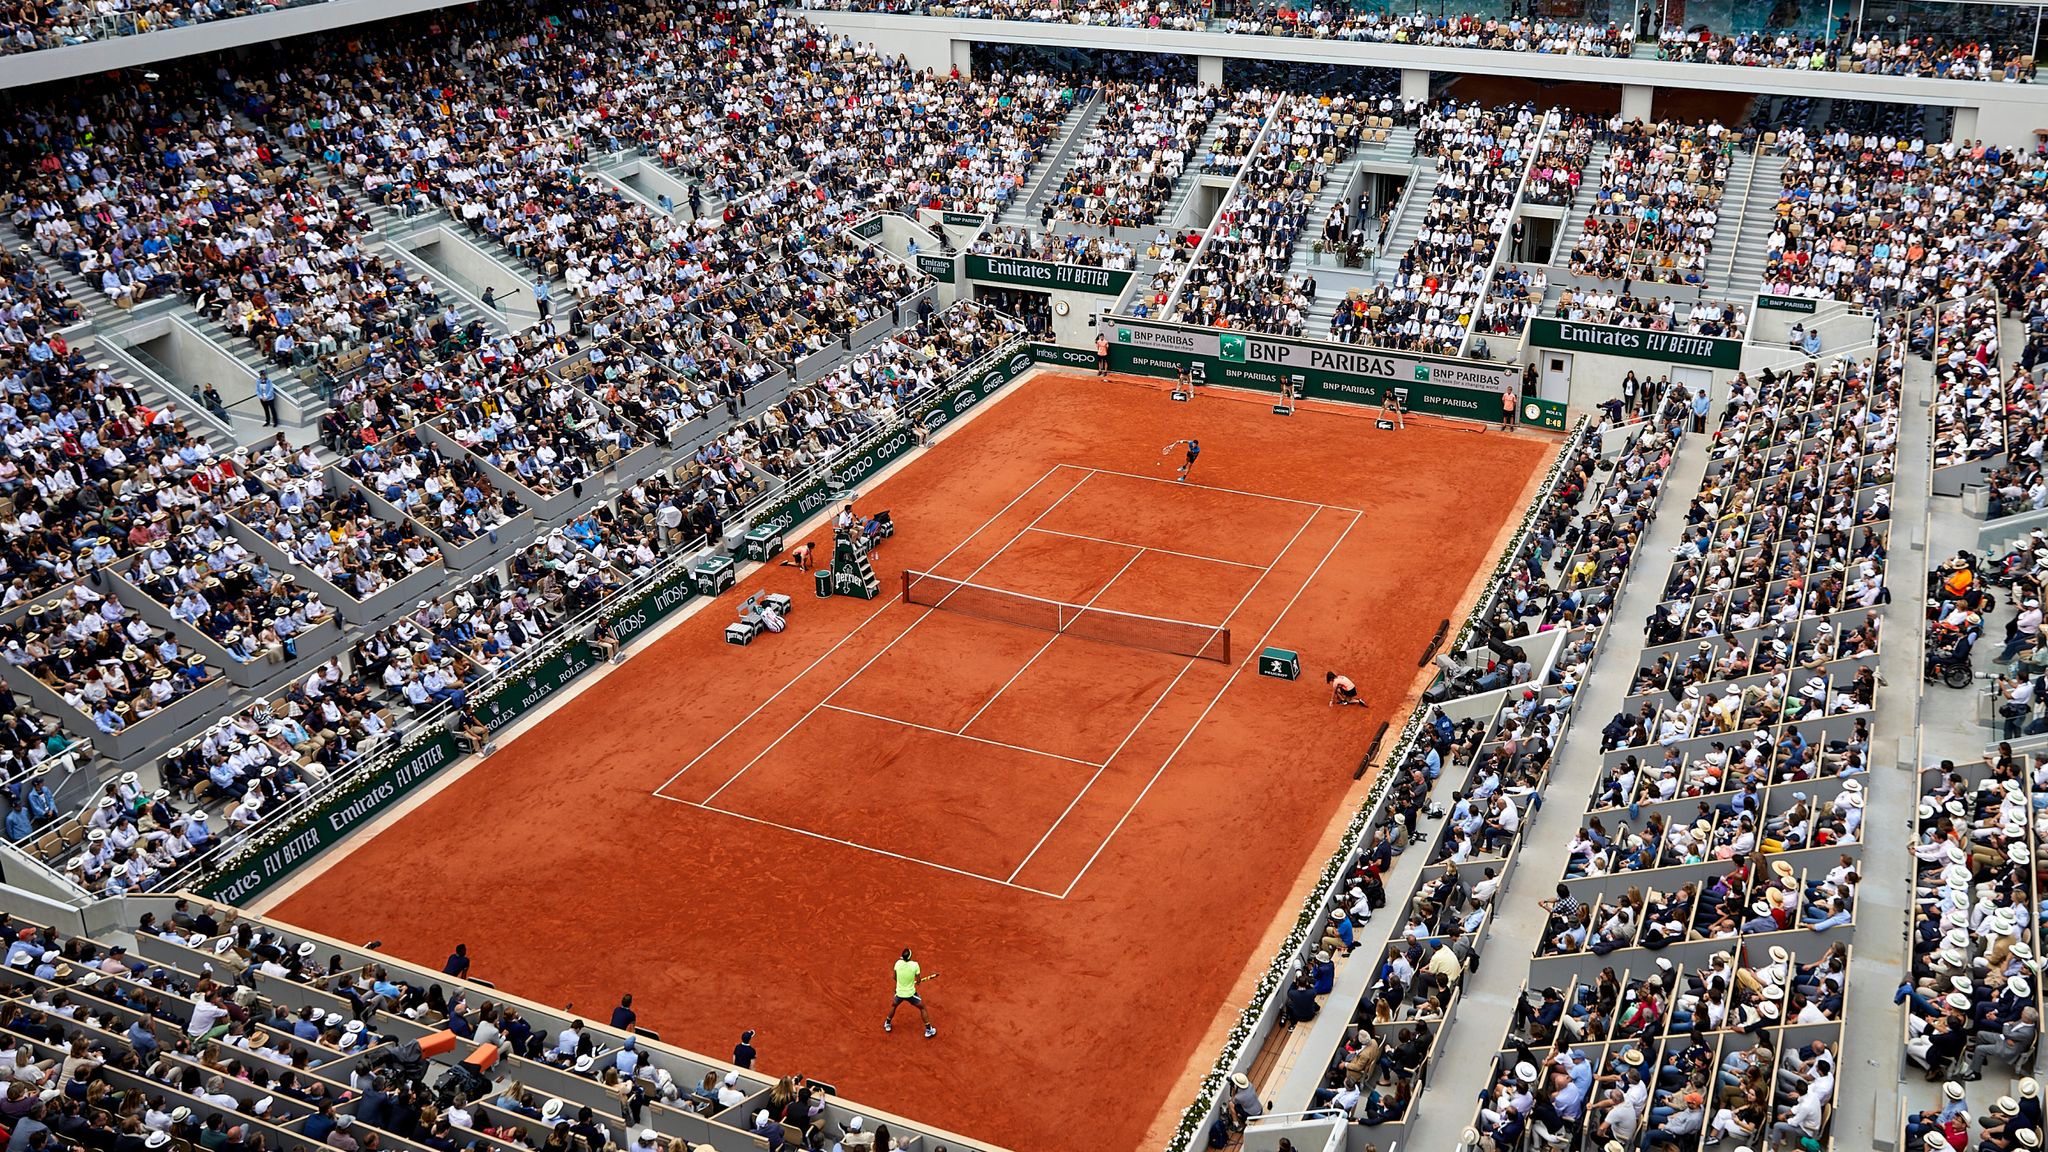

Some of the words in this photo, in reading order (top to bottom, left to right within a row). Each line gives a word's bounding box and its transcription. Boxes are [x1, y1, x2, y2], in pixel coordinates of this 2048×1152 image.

[921, 258, 950, 268] Emirates
[987, 258, 1050, 279] Emirates
[1056, 266, 1072, 282] FLY
[1074, 268, 1109, 287] BETTER
[1134, 331, 1153, 340] BNP
[1155, 334, 1194, 346] PARIBAS
[1560, 324, 1640, 348] Emirates
[1646, 333, 1668, 351] FLY
[1669, 336, 1713, 357] BETTER
[1036, 348, 1057, 359] Infosys
[1063, 352, 1095, 363] oppo
[1133, 357, 1148, 365] BNP
[1150, 358, 1181, 369] PARIBAS
[1250, 342, 1290, 362] BNP
[1310, 350, 1396, 376] PARIBAS
[1226, 369, 1242, 378] BNP
[1244, 371, 1276, 382] PARIBAS
[1434, 369, 1454, 378] BNP
[1457, 372, 1499, 385] PARIBAS
[1323, 382, 1340, 391] BNP
[1341, 384, 1375, 395] PARIBAS
[1424, 395, 1441, 404] BNP
[1442, 397, 1478, 409] PARIBAS
[877, 433, 907, 459] oppo
[842, 456, 873, 482] oppo
[798, 488, 826, 514] Infosys
[771, 511, 793, 528] fosys
[654, 581, 688, 612] Infosys
[610, 609, 646, 639] Infosys
[558, 658, 588, 683] ROLEX
[522, 682, 552, 708] ROLEX
[486, 707, 516, 732] ROLEX
[328, 780, 394, 832] Emirates
[395, 766, 416, 788] FLY
[412, 743, 445, 777] BETTER
[213, 870, 261, 904] irates
[263, 851, 284, 877] FLY
[284, 827, 320, 865] BETTER
